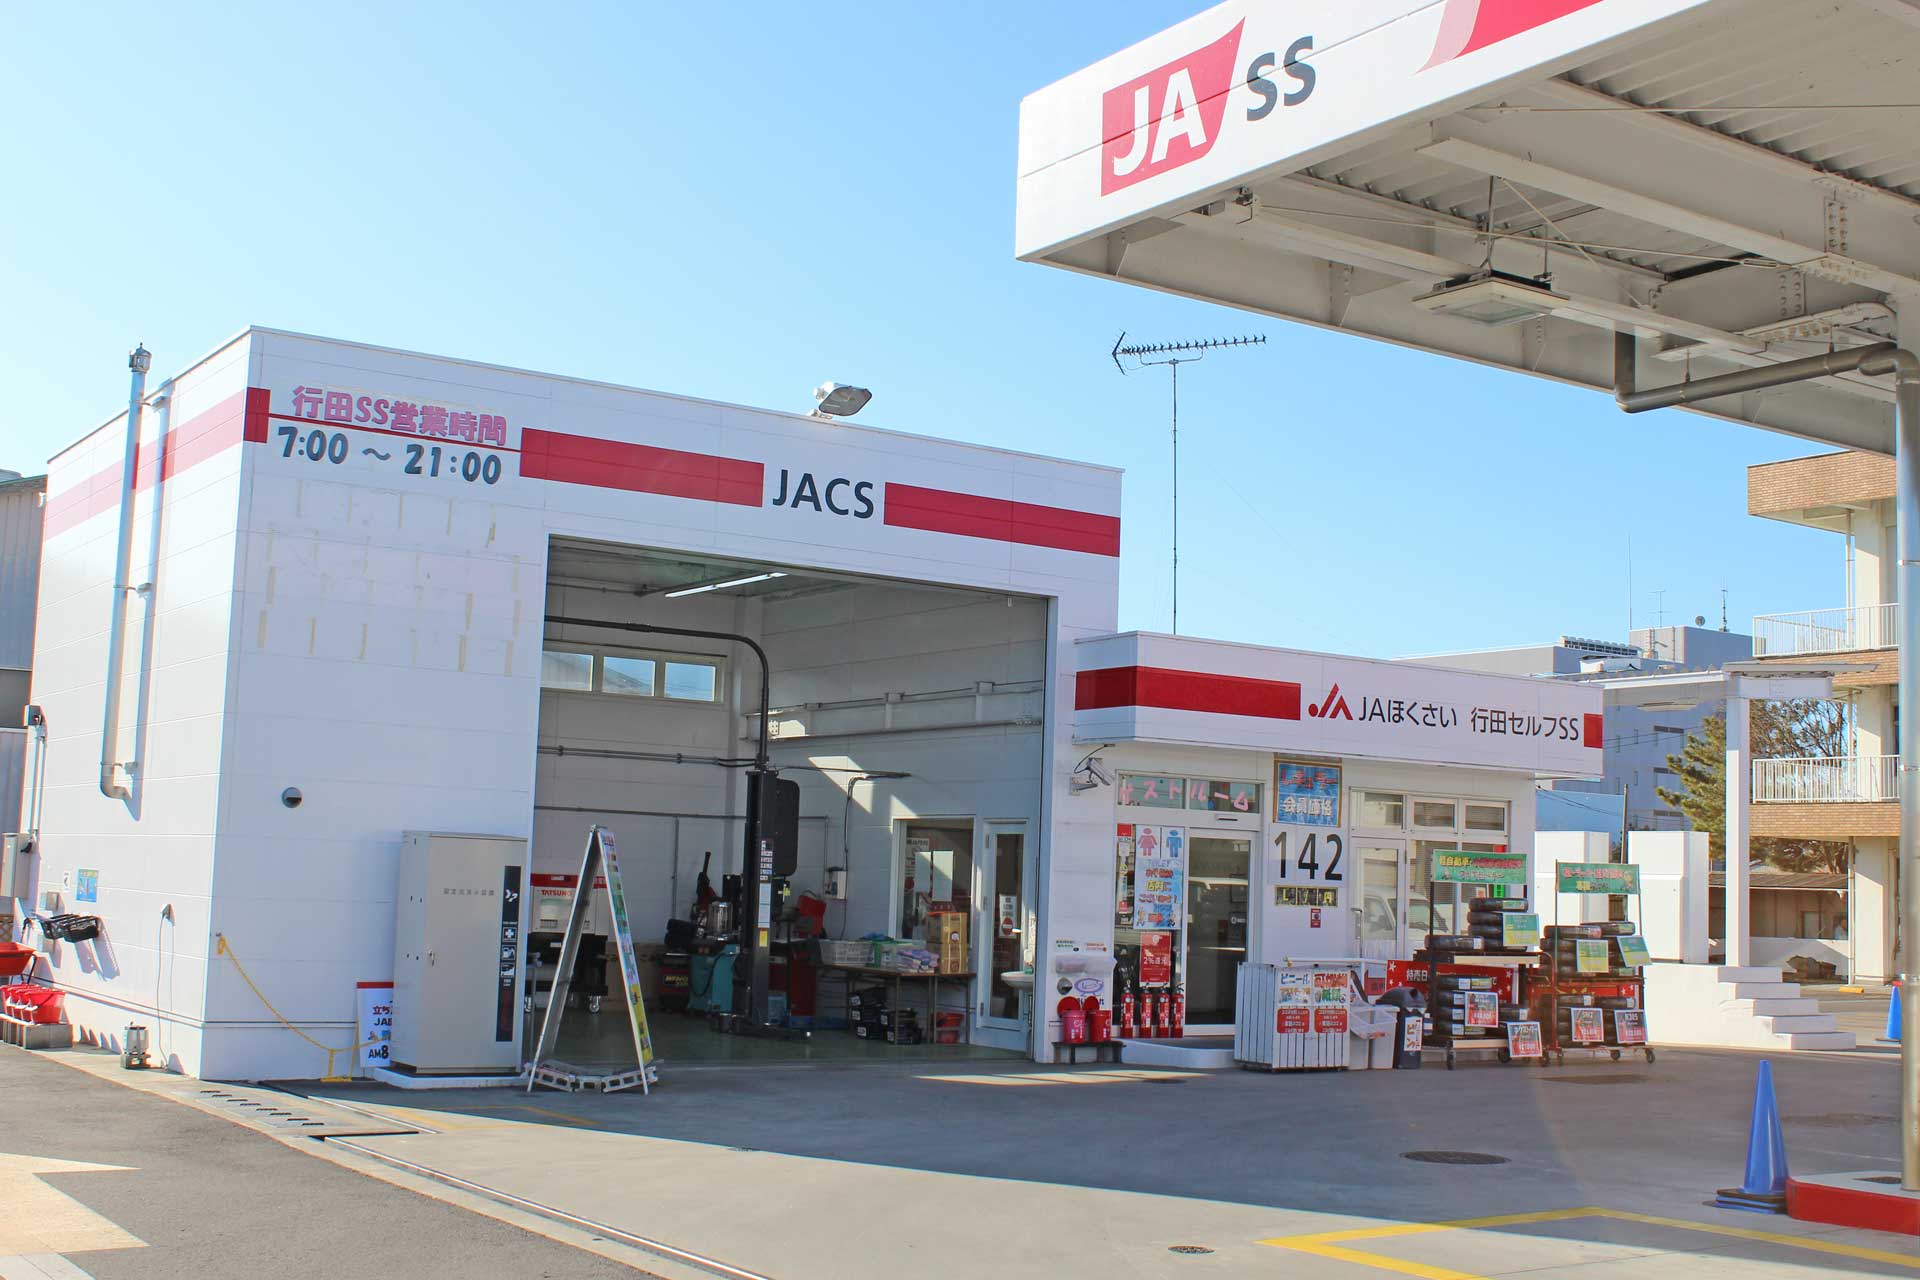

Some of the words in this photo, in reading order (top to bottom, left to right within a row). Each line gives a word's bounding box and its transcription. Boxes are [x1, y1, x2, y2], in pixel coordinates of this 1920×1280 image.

[1113, 67, 1211, 177] JA
[1246, 36, 1316, 121] SS
[292, 385, 508, 447] 行田SS営業時間
[277, 427, 348, 464] 7:00
[405, 444, 502, 486] 21:00
[772, 469, 875, 520] JACS
[1358, 696, 1458, 729] JAほくさい
[1470, 707, 1580, 742] 行田セルフSS
[1283, 796, 1333, 817] 会員価格
[1274, 831, 1343, 881] 142
